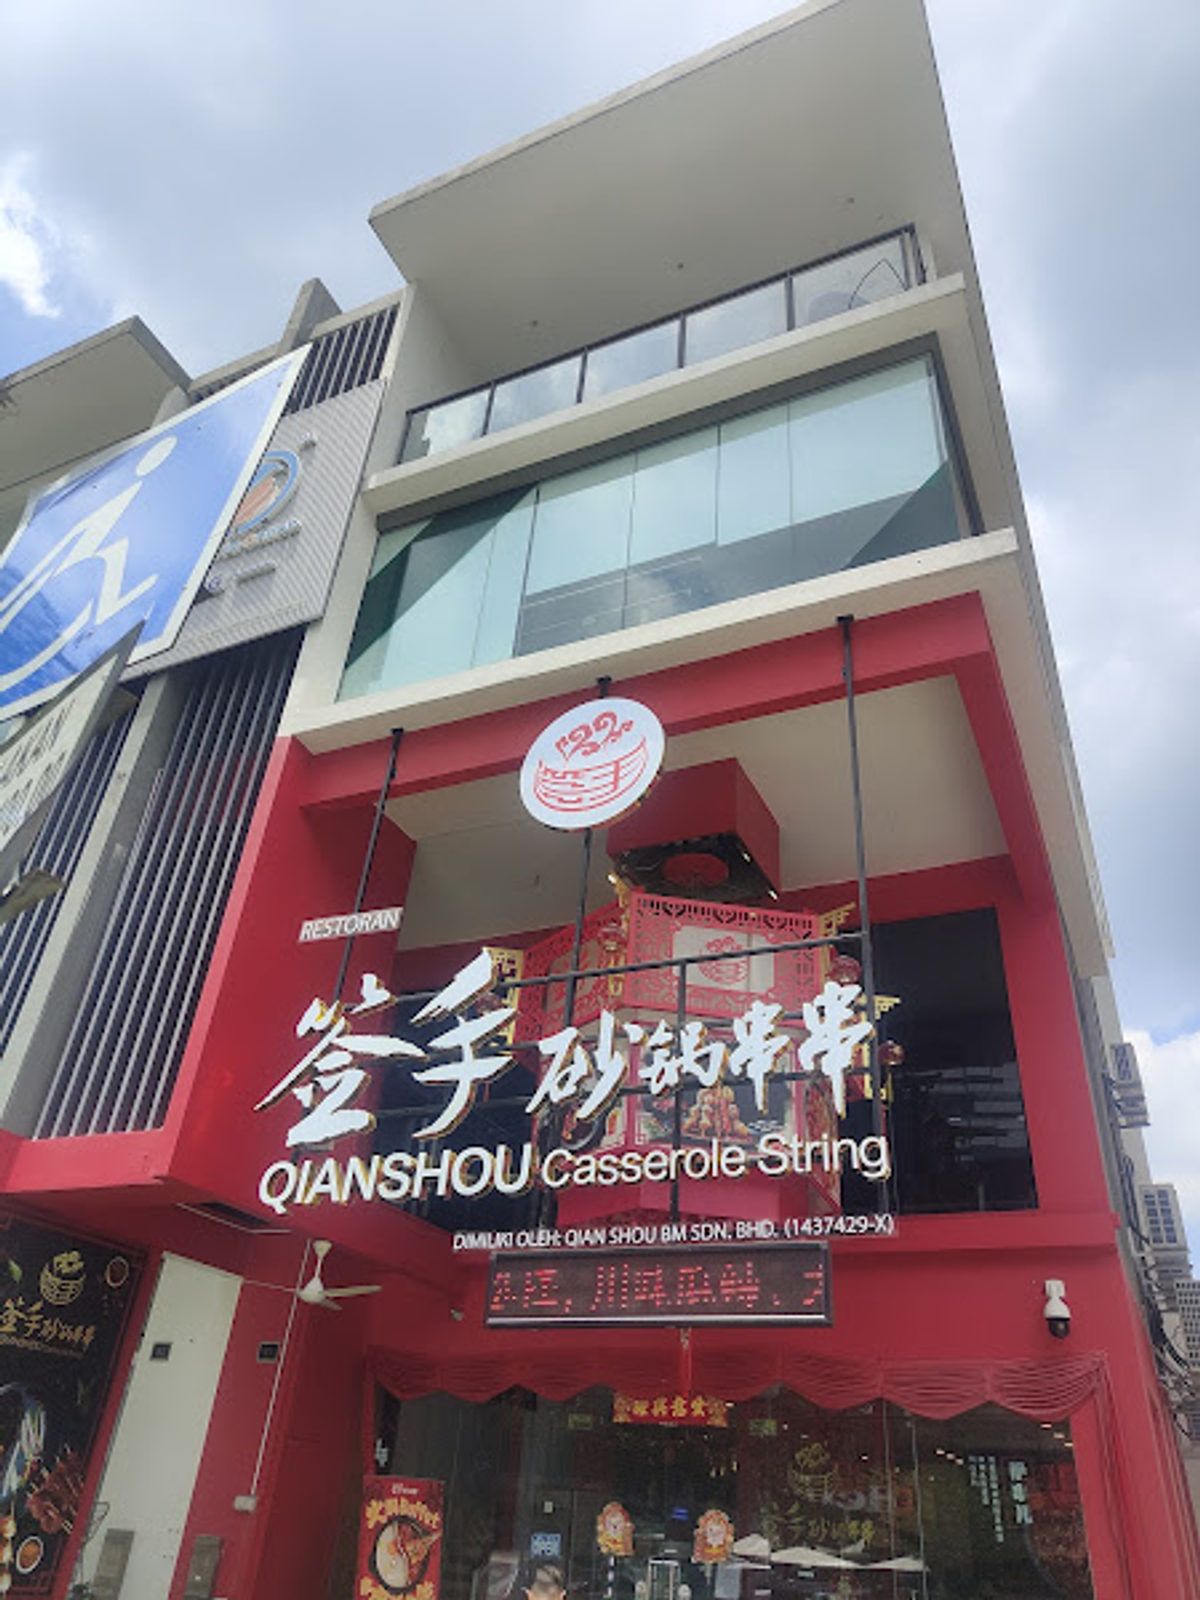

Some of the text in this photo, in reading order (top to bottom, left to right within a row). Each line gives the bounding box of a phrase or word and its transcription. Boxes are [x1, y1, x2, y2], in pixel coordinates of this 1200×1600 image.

[298, 908, 402, 942] RESTORAN
[258, 1131, 888, 1214] QIANSHOU Casserole String
[516, 1228, 561, 1248] OLEH:
[564, 1228, 606, 1248] QIAN
[609, 1225, 657, 1245] SHOU
[660, 1223, 687, 1242] BM
[690, 1222, 732, 1242] SDN.
[735, 1219, 779, 1240] BHD.
[783, 1213, 895, 1239] (1437429-X)
